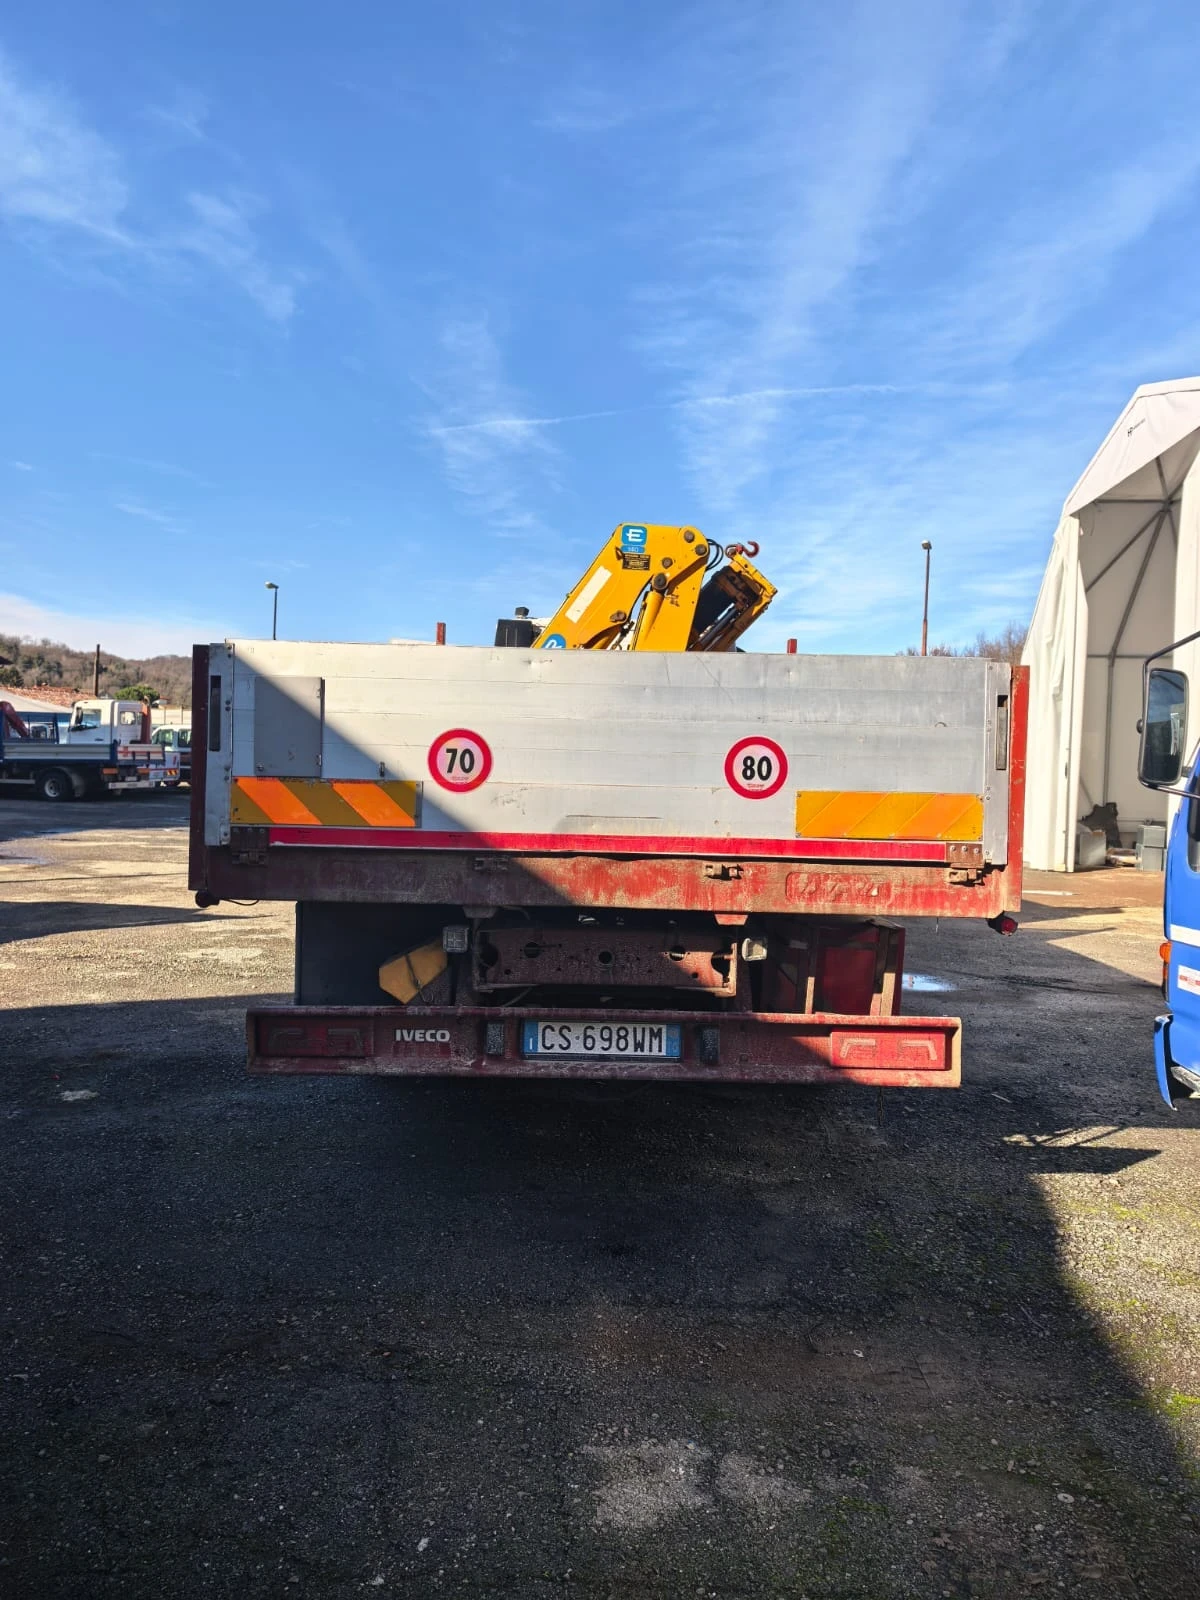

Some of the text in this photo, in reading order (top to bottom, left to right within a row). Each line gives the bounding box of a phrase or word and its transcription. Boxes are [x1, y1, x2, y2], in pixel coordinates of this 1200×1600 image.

[446, 748, 475, 774] 70
[742, 755, 772, 781] 80
[395, 1029, 451, 1042] IVECO
[541, 1025, 663, 1053] CS 698WM
